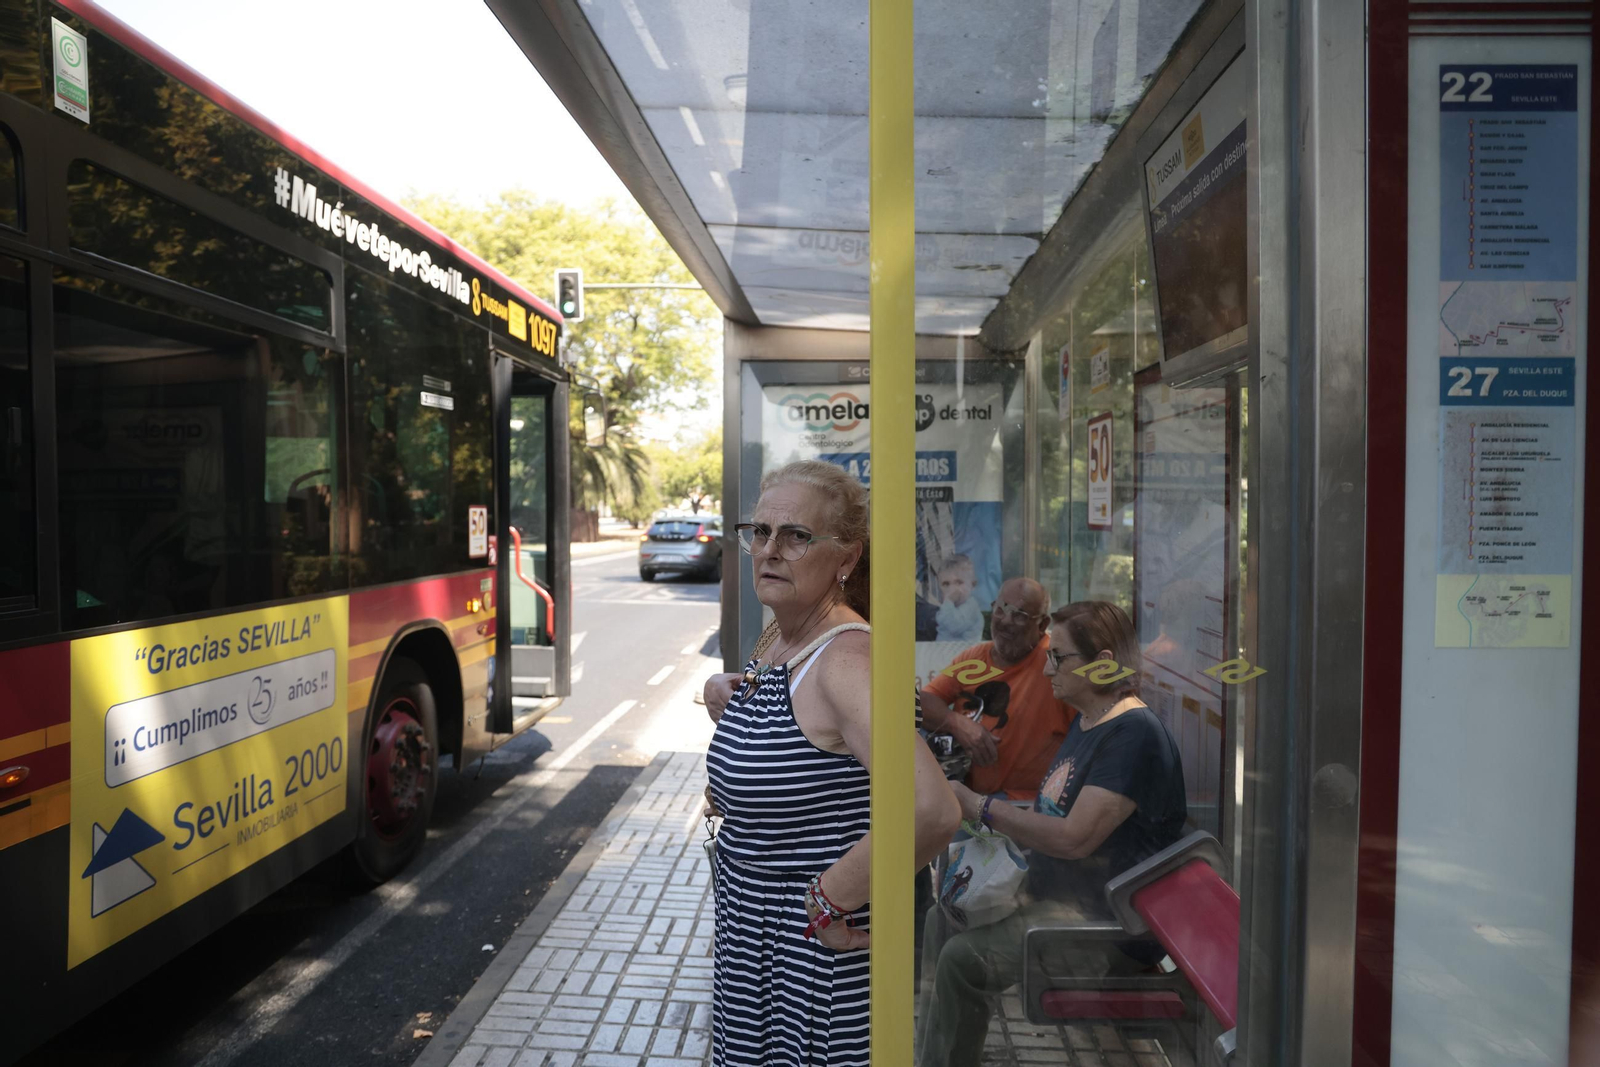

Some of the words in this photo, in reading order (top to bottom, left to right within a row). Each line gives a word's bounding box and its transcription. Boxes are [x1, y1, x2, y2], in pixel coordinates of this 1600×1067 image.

[1441, 71, 1493, 102] 22
[1157, 149, 1182, 186] TUSSAM
[1193, 174, 1210, 198] salida
[1211, 162, 1223, 181] con
[274, 167, 470, 305] #MuéveteporSevilla
[529, 312, 556, 357] 1097
[1447, 366, 1499, 396] 27
[1508, 367, 1540, 375] SEVILLA
[1542, 367, 1563, 375] ESTE
[1502, 389, 1520, 397] PZA.
[1522, 389, 1538, 397] DEL
[1540, 389, 1567, 397] DUQUE
[940, 404, 992, 421] dental
[1090, 423, 1110, 483] 50
[471, 510, 485, 536] 50
[133, 703, 238, 752] Cumplimos
[250, 675, 273, 716] 25
[172, 774, 275, 852] Sevilla
[284, 736, 342, 797] 2000
[236, 802, 298, 847] INMOBILIARIA
